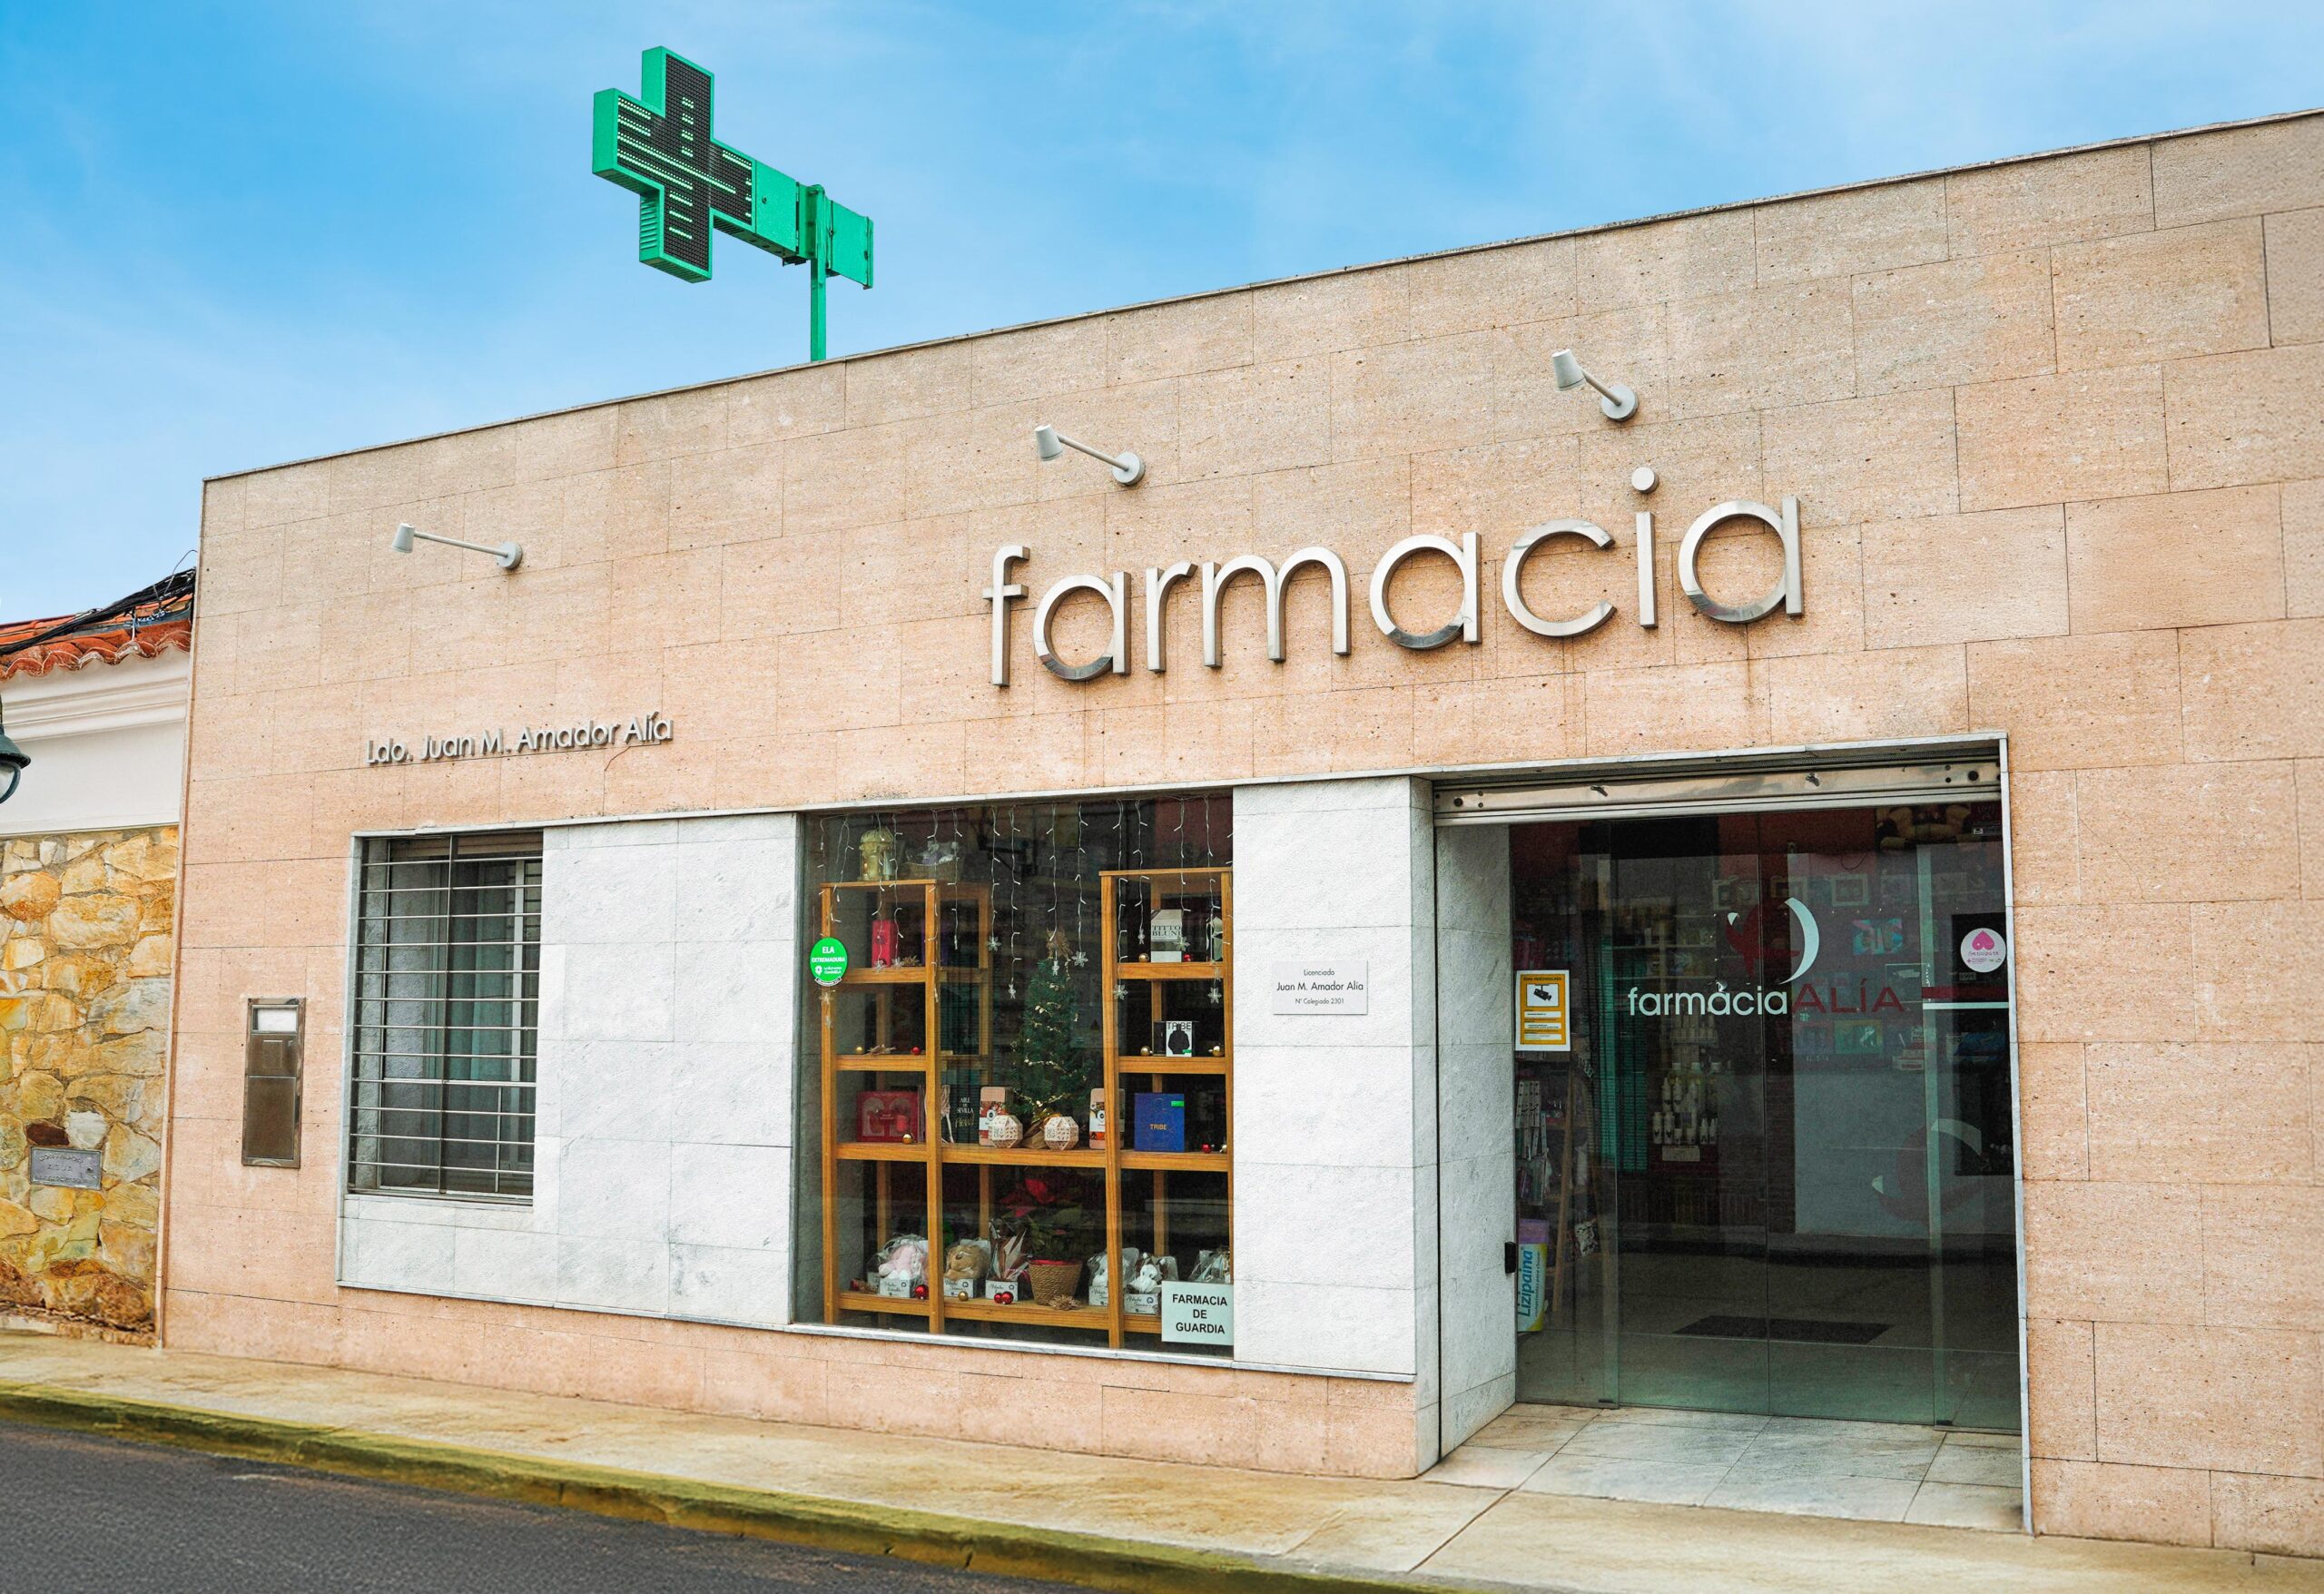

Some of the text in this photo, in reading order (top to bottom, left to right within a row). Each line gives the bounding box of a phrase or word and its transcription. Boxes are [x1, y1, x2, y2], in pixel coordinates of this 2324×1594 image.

[983, 466, 1804, 687] farmacia
[366, 711, 674, 764] Ldo. Juan M. Amador Alía
[1304, 968, 1335, 977] Licenciado
[1276, 980, 1364, 991] Juan M. Amador Alía
[1303, 998, 1330, 1006] Colegiado
[1628, 979, 1905, 1017] farmacia ALÍA
[1167, 1021, 1191, 1030] TRBE
[1518, 1250, 1534, 1317] Lizipaina
[1172, 1294, 1228, 1306] FARMACIA
[1193, 1309, 1207, 1319] DE
[1176, 1323, 1226, 1334] GUARDIA
